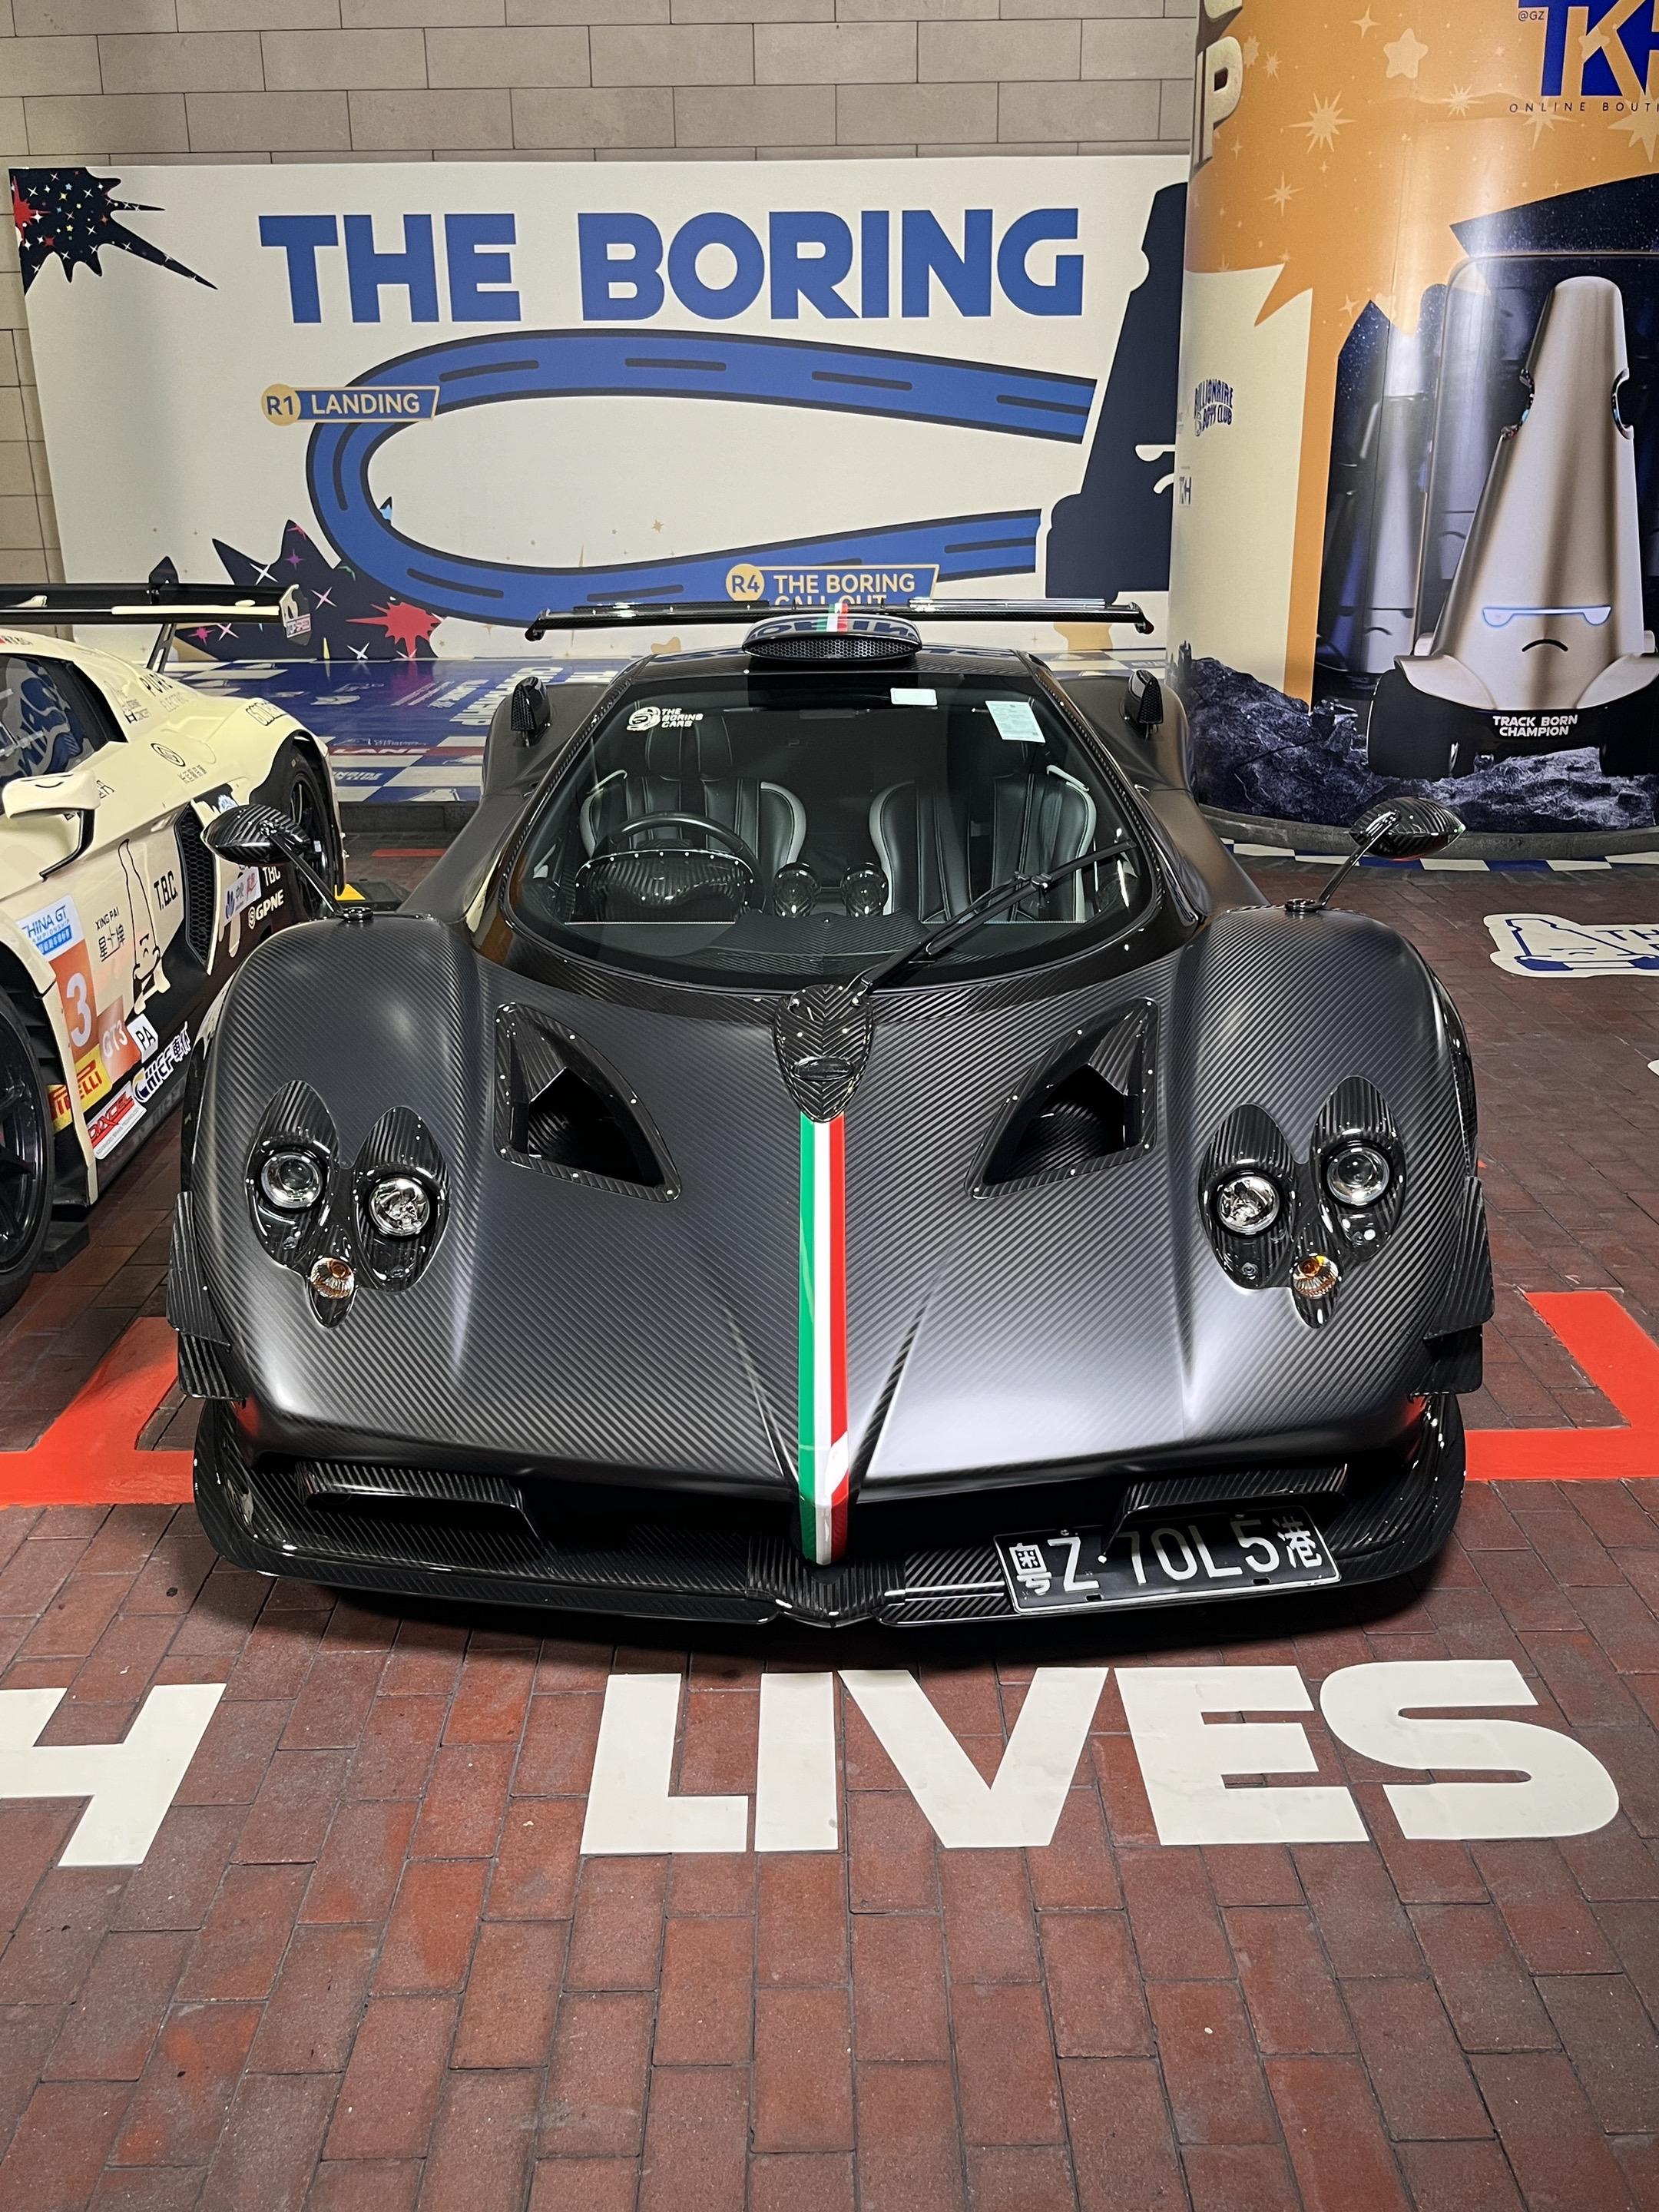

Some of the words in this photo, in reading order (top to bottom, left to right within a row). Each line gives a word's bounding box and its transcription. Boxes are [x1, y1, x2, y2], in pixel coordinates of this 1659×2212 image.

[1518, 11, 1545, 22] @GZ
[1509, 102, 1586, 113] ONLINE
[259, 213, 522, 324] THE
[578, 208, 1084, 321] BORING
[266, 396, 294, 416] R1
[311, 392, 420, 415] LANDING
[1217, 404, 1232, 426] CLUB
[731, 575, 760, 593] R4
[773, 575, 820, 594] THE
[826, 573, 916, 593] BORING
[661, 713, 704, 721] BORING
[661, 720, 693, 728] CARS
[1492, 715, 1536, 727] TRACK
[1541, 714, 1578, 727] BORN
[1498, 726, 1569, 737] CHAMPION
[55, 905, 67, 922] GT
[256, 889, 284, 921] GPNE
[94, 913, 109, 931] XING
[66, 972, 92, 1048] 3
[102, 1019, 128, 1058] GT3
[135, 1026, 156, 1051] PA
[581, 1659, 1620, 1856] LIVES
